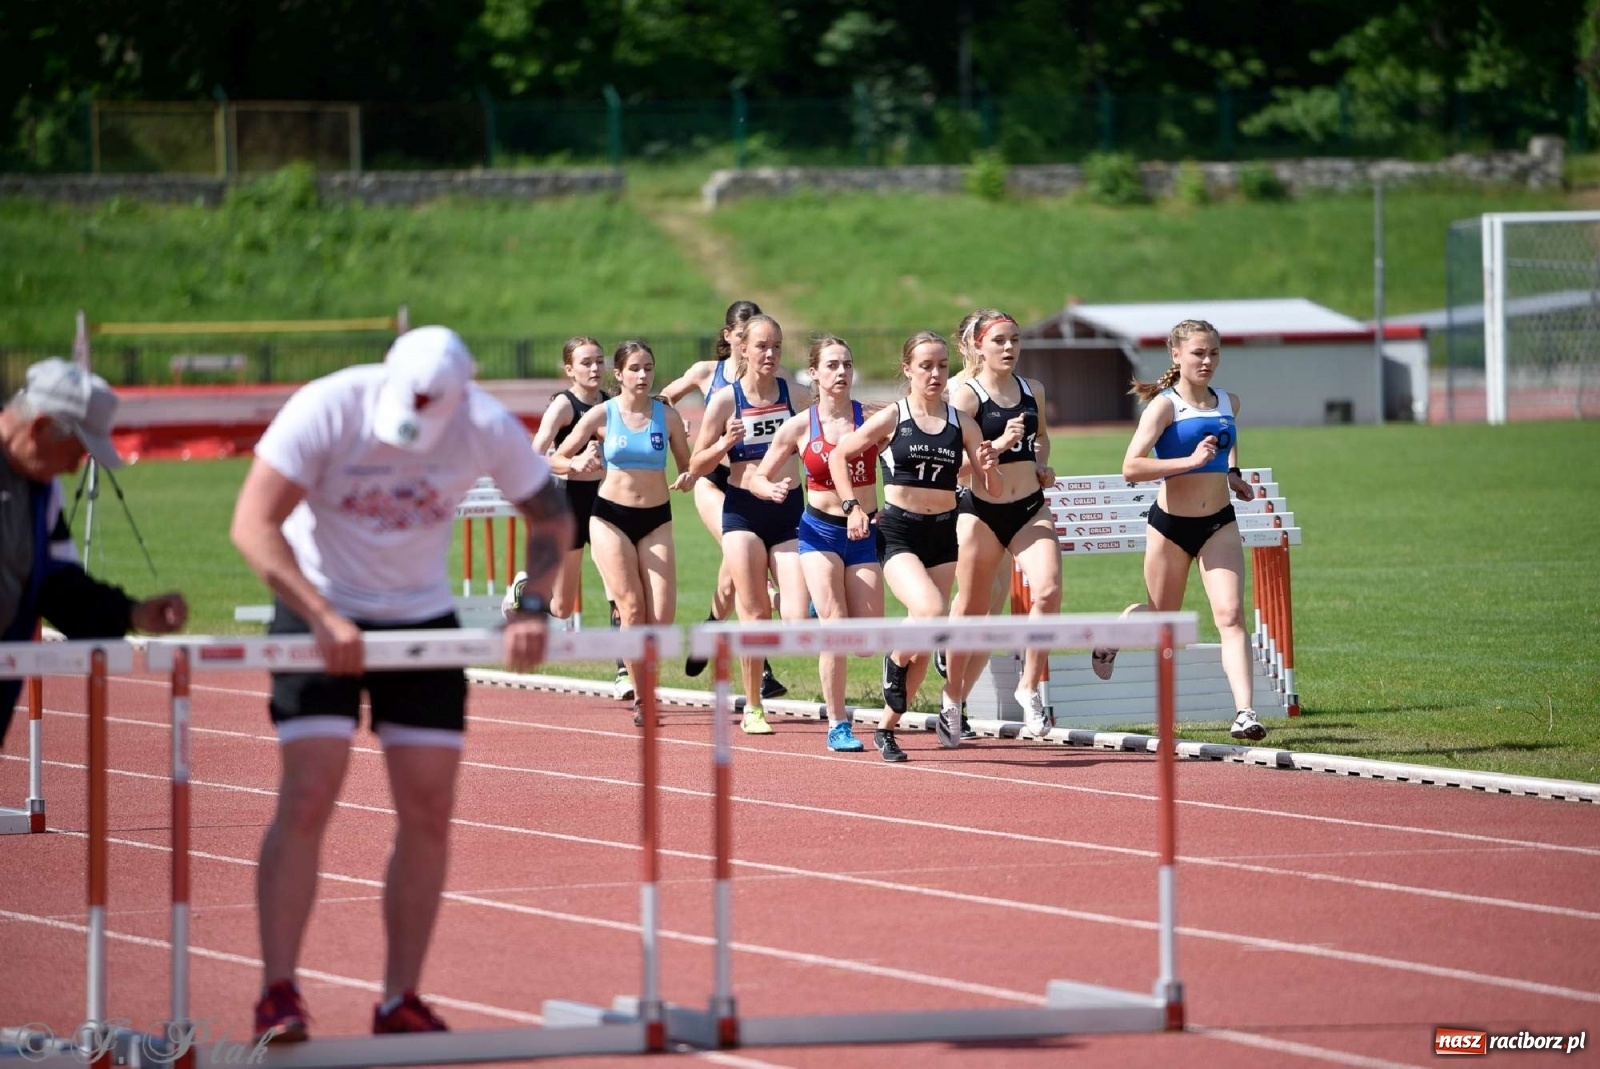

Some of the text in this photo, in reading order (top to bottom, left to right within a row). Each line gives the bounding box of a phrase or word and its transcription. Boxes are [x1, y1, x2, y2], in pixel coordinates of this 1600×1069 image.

[753, 418, 785, 437] 557
[909, 444, 929, 453] MKS
[937, 447, 956, 458] SMS
[915, 461, 944, 482] 17
[1069, 482, 1091, 490] ORLEN
[1074, 497, 1096, 505] ORLEN
[1080, 512, 1102, 521] ORLEN
[1090, 527, 1112, 535] ORLEN
[1098, 541, 1120, 549] ORLEN
